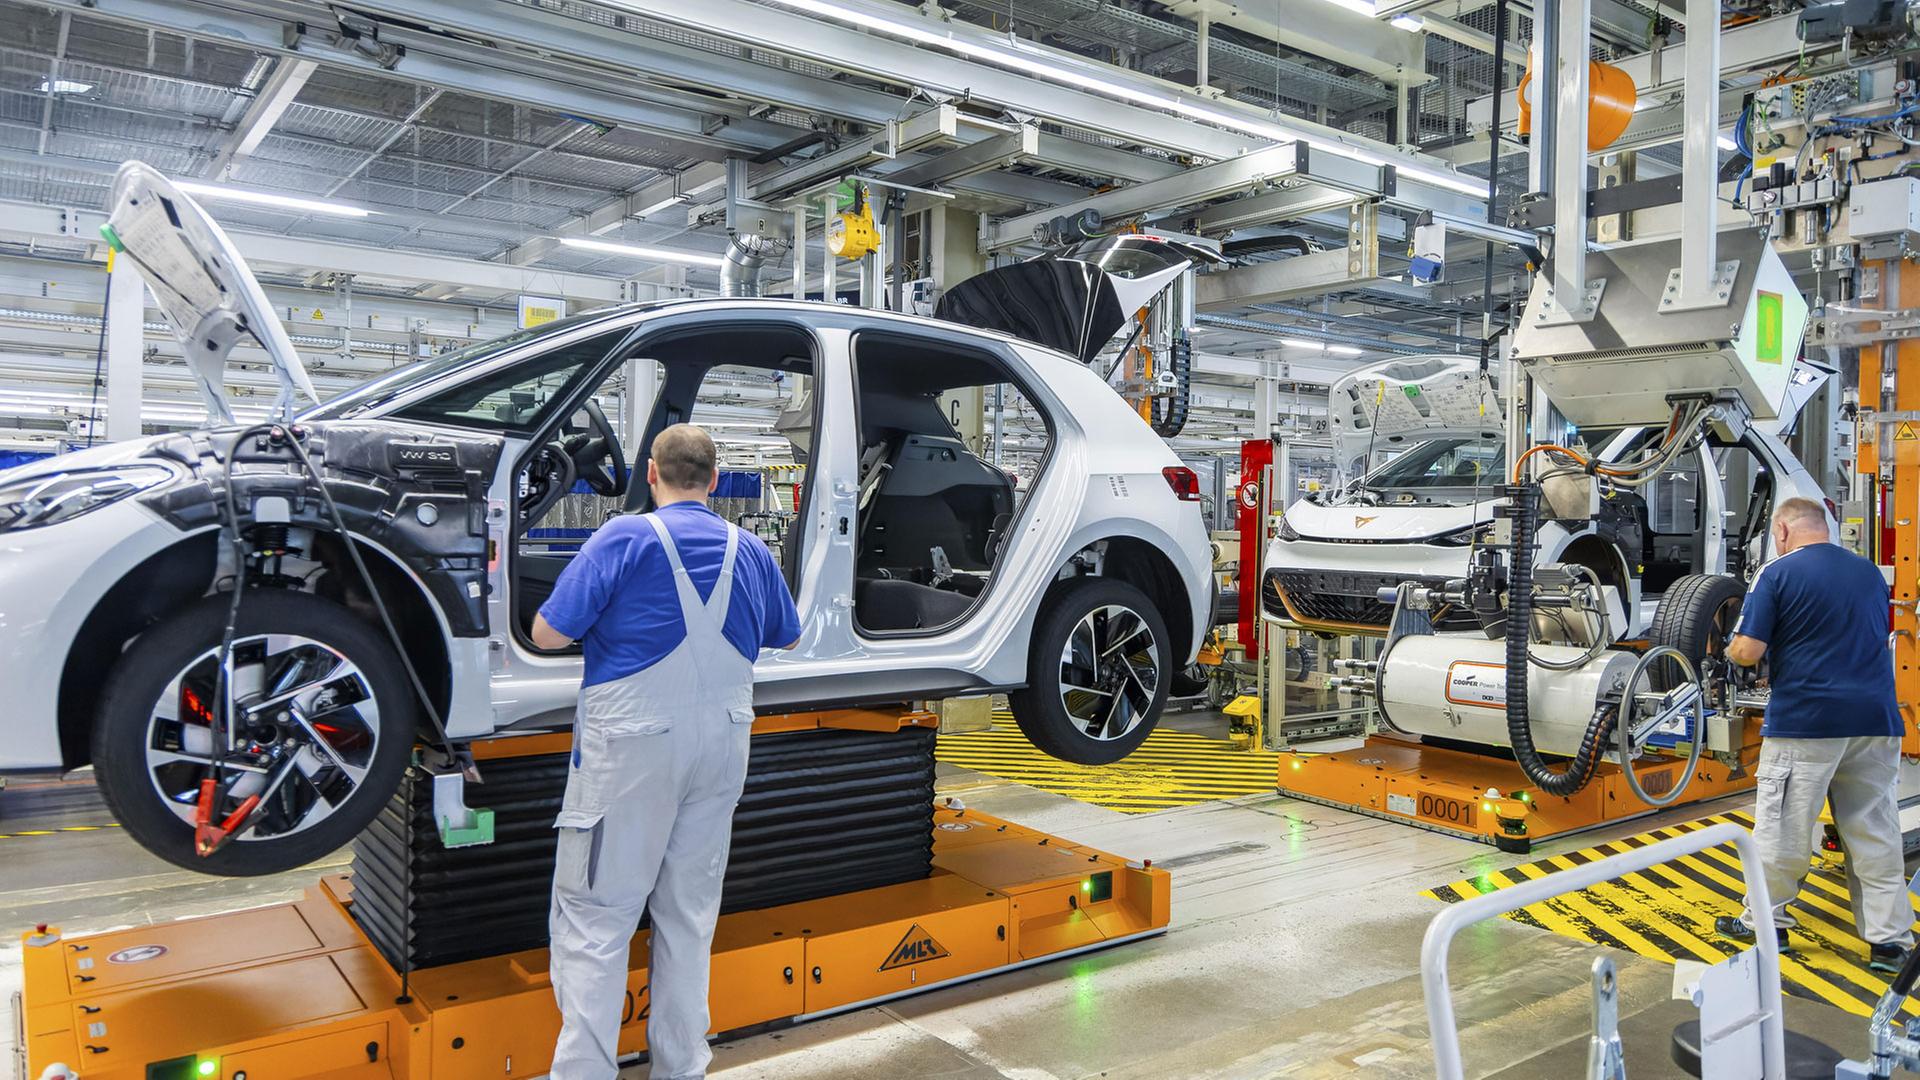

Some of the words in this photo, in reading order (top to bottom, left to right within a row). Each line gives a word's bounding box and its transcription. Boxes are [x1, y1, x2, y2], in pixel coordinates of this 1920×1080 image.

[758, 219, 765, 231] R
[951, 400, 960, 427] C
[1316, 420, 1327, 431] 29
[400, 451, 424, 459] VW
[1453, 679, 1479, 688] COOPER
[1422, 795, 1470, 824] 0001
[893, 938, 937, 964] MLR
